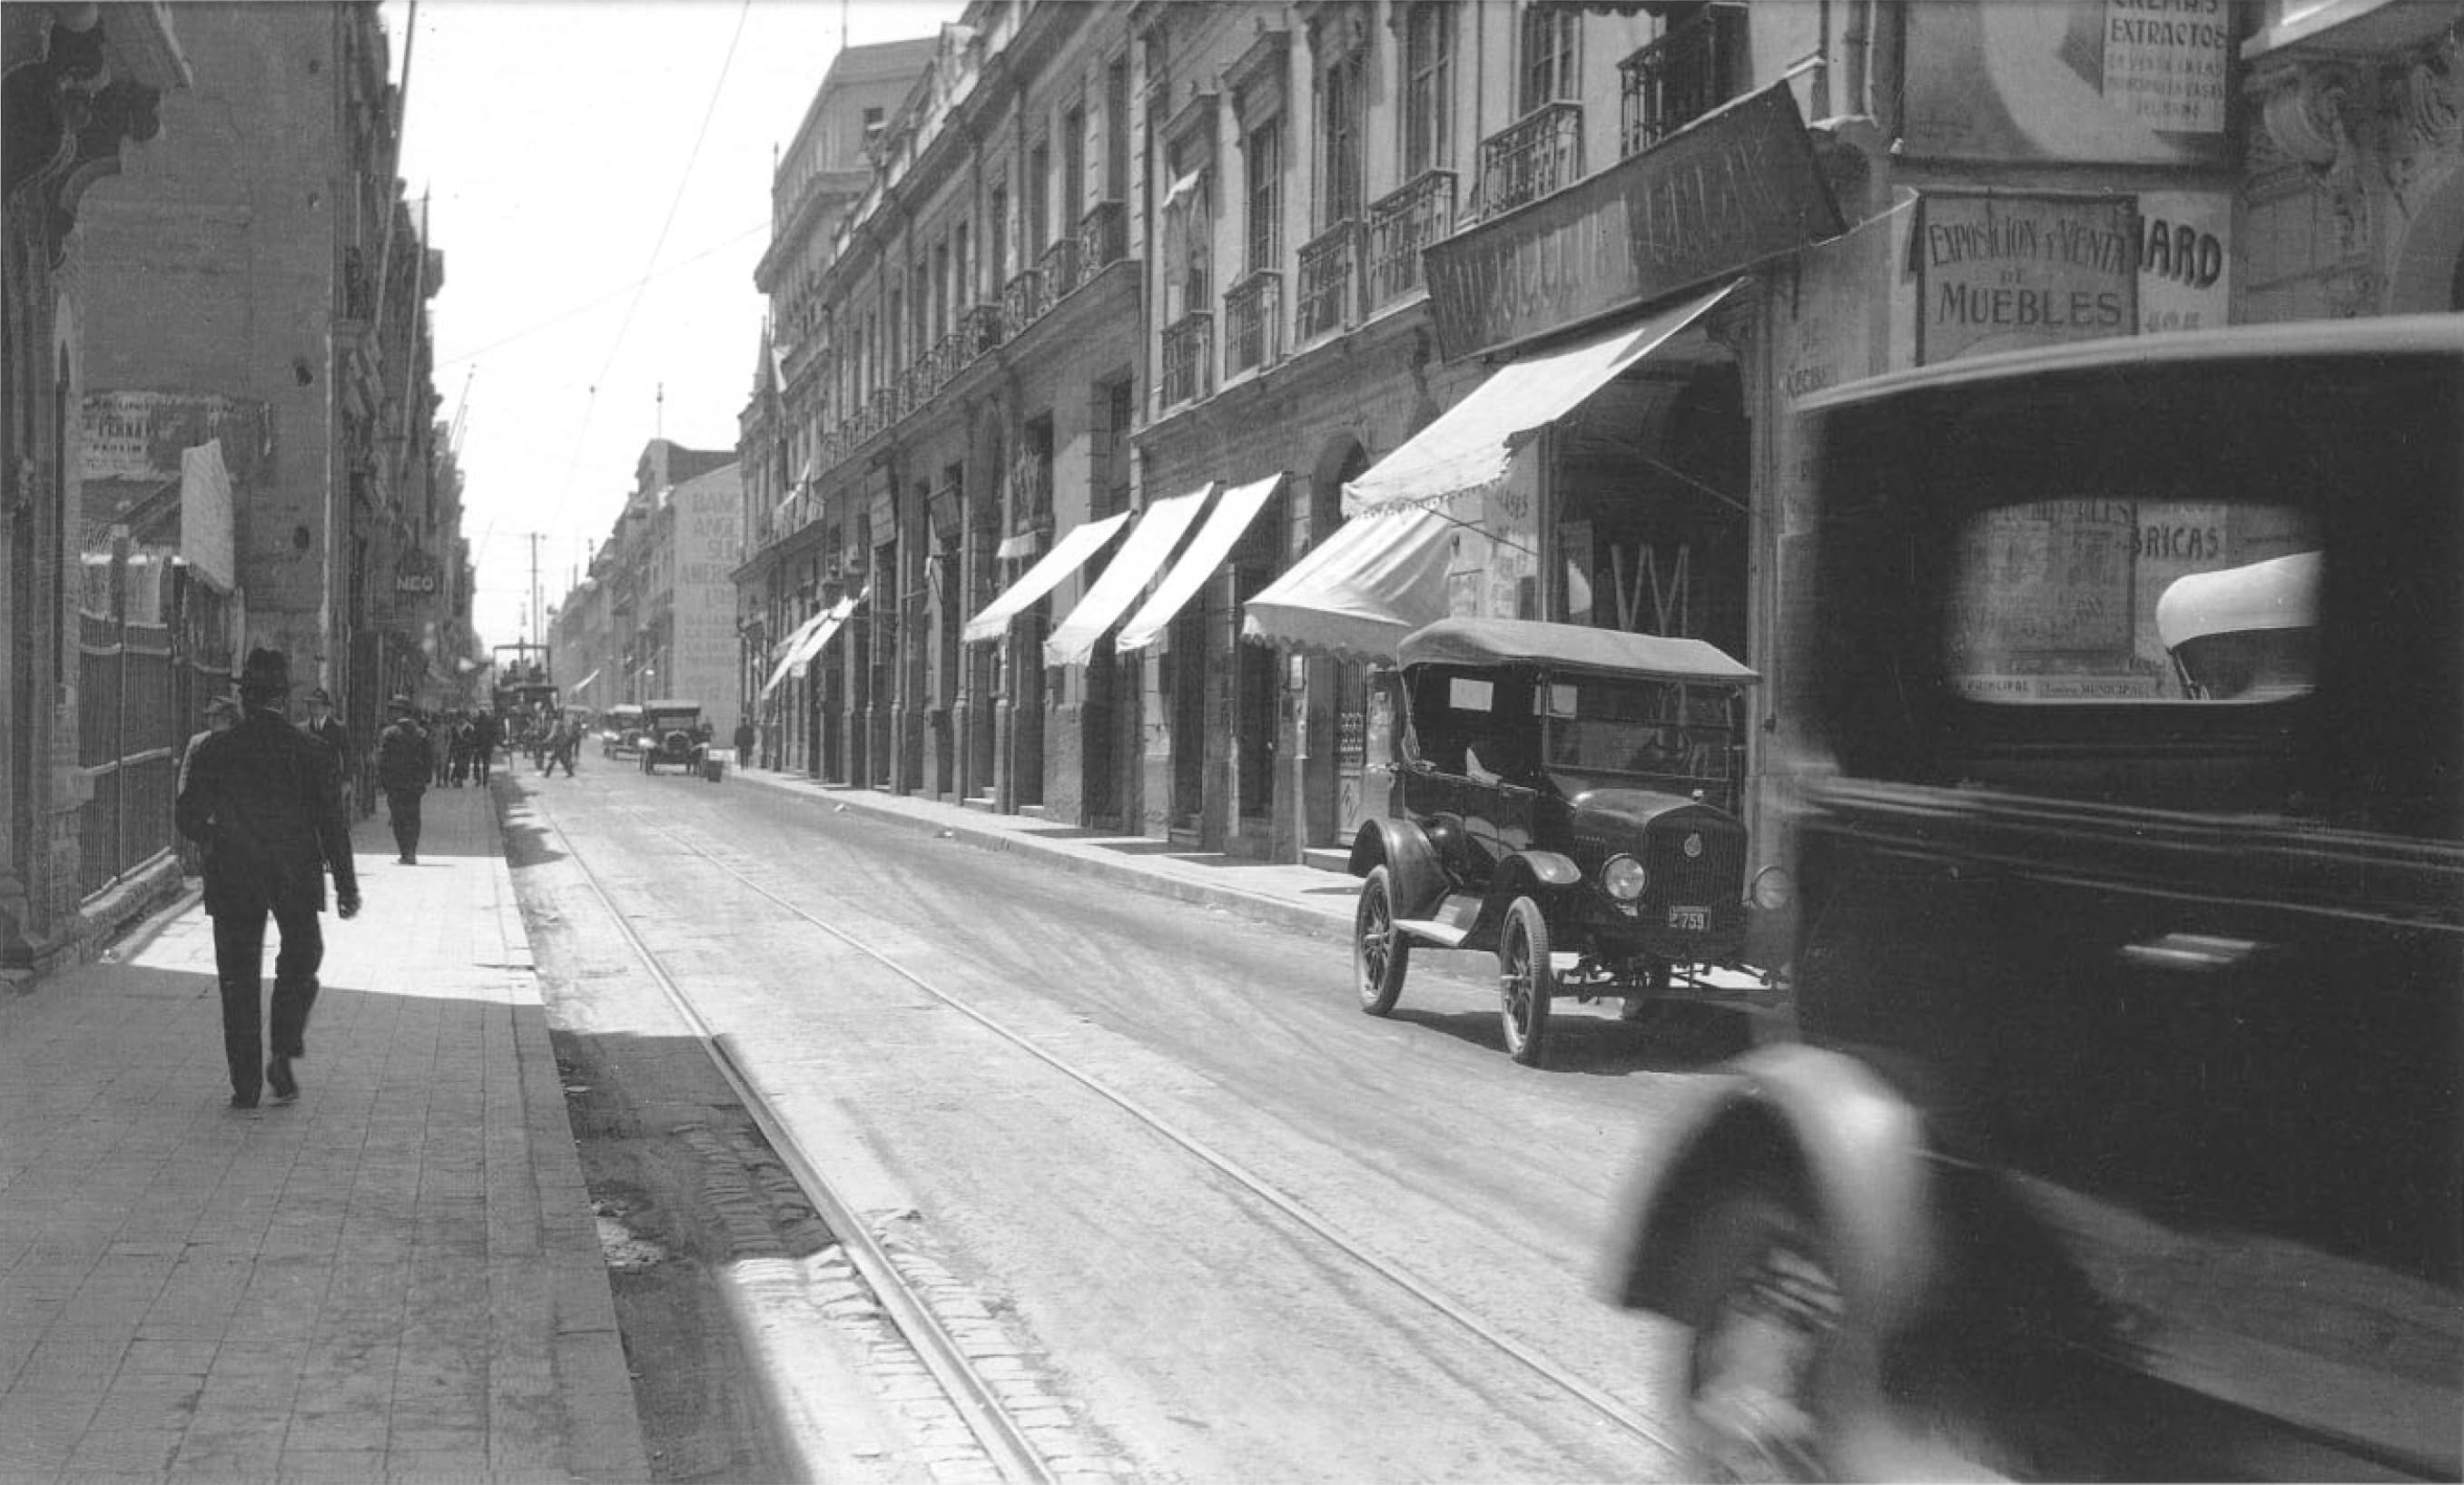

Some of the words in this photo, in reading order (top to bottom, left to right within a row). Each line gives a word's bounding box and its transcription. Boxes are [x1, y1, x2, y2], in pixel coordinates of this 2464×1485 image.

[2111, 19, 2229, 49] EXTRACTOS
[1929, 216, 2039, 267] EXPOSICION
[2056, 218, 2125, 277] VENTA
[1938, 281, 2123, 327] MUEBLES
